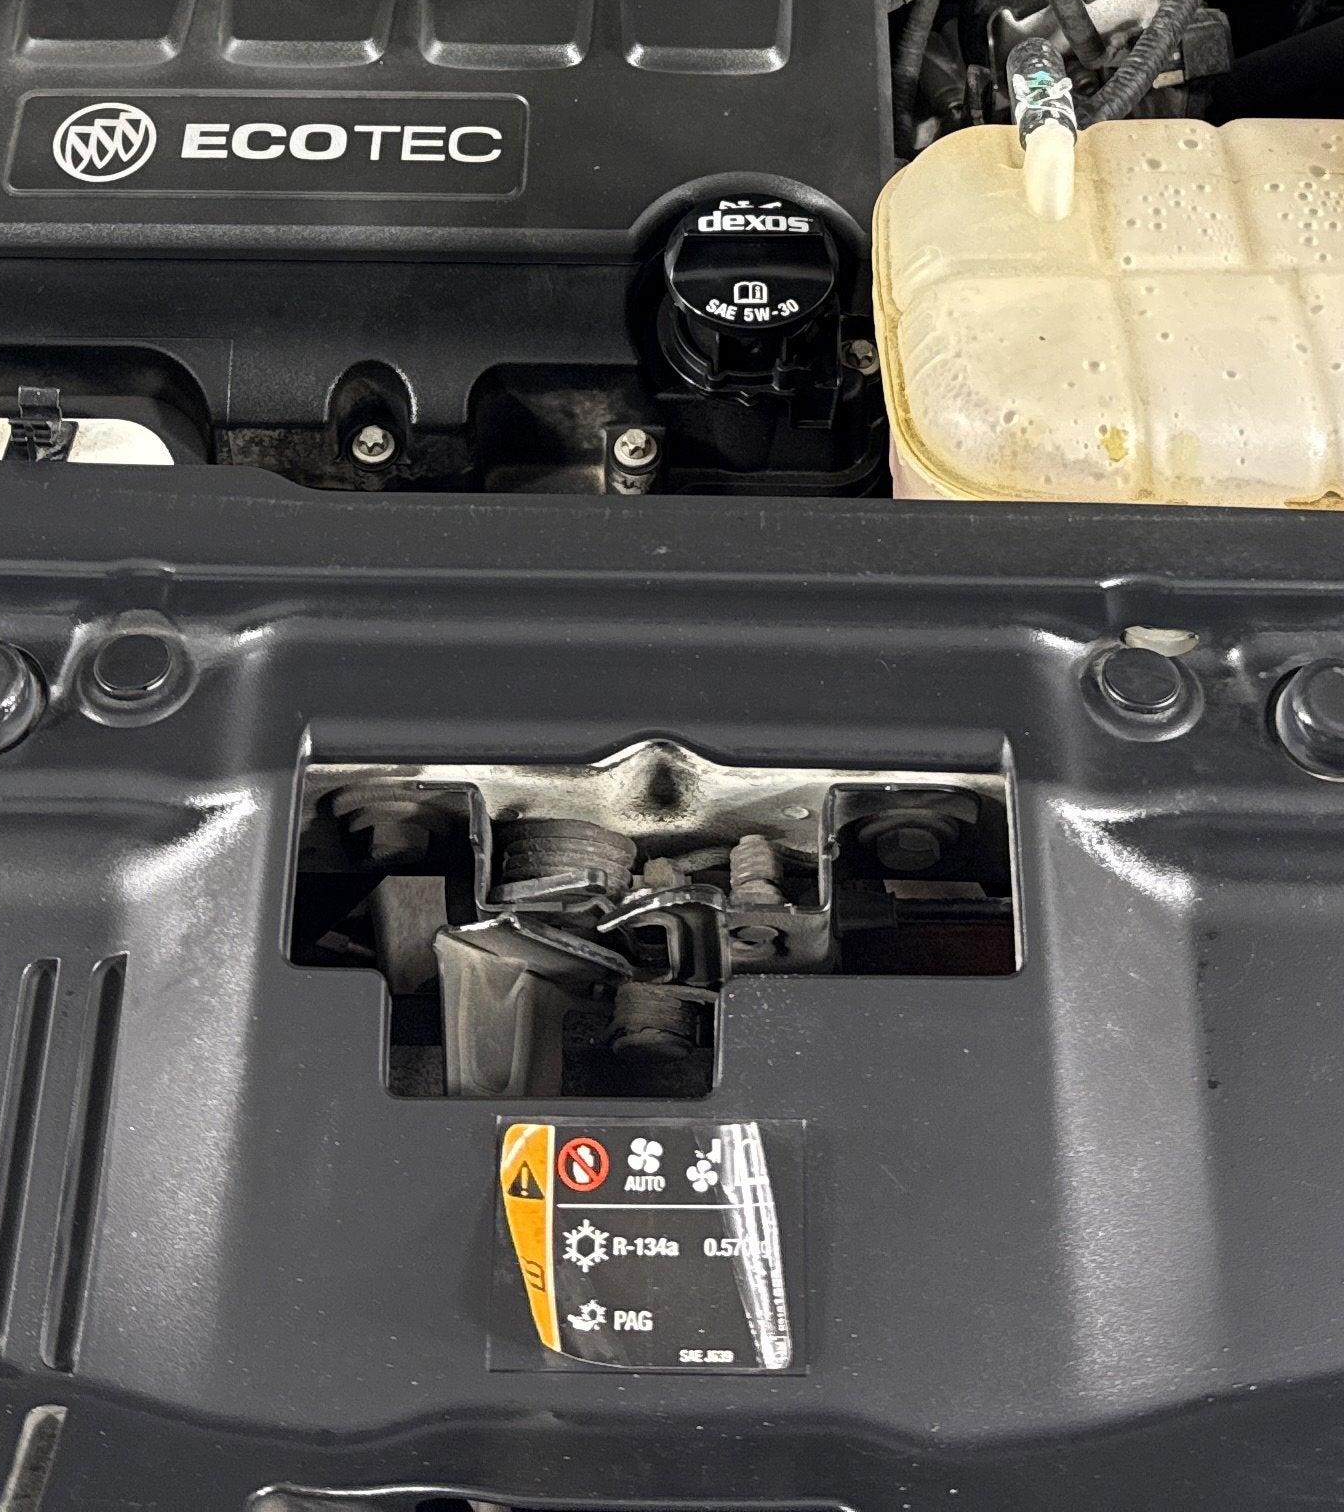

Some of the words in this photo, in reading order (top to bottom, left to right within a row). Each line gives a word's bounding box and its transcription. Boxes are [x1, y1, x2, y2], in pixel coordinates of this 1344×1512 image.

[181, 121, 503, 164] ECOTEC
[697, 210, 810, 233] dexos
[706, 298, 738, 321] SAE
[743, 298, 800, 322] 5W-30
[624, 1175, 666, 1192] AUTO
[612, 1238, 679, 1257] R-134a
[613, 1310, 653, 1332] PAG
[679, 1349, 702, 1363] SAE
